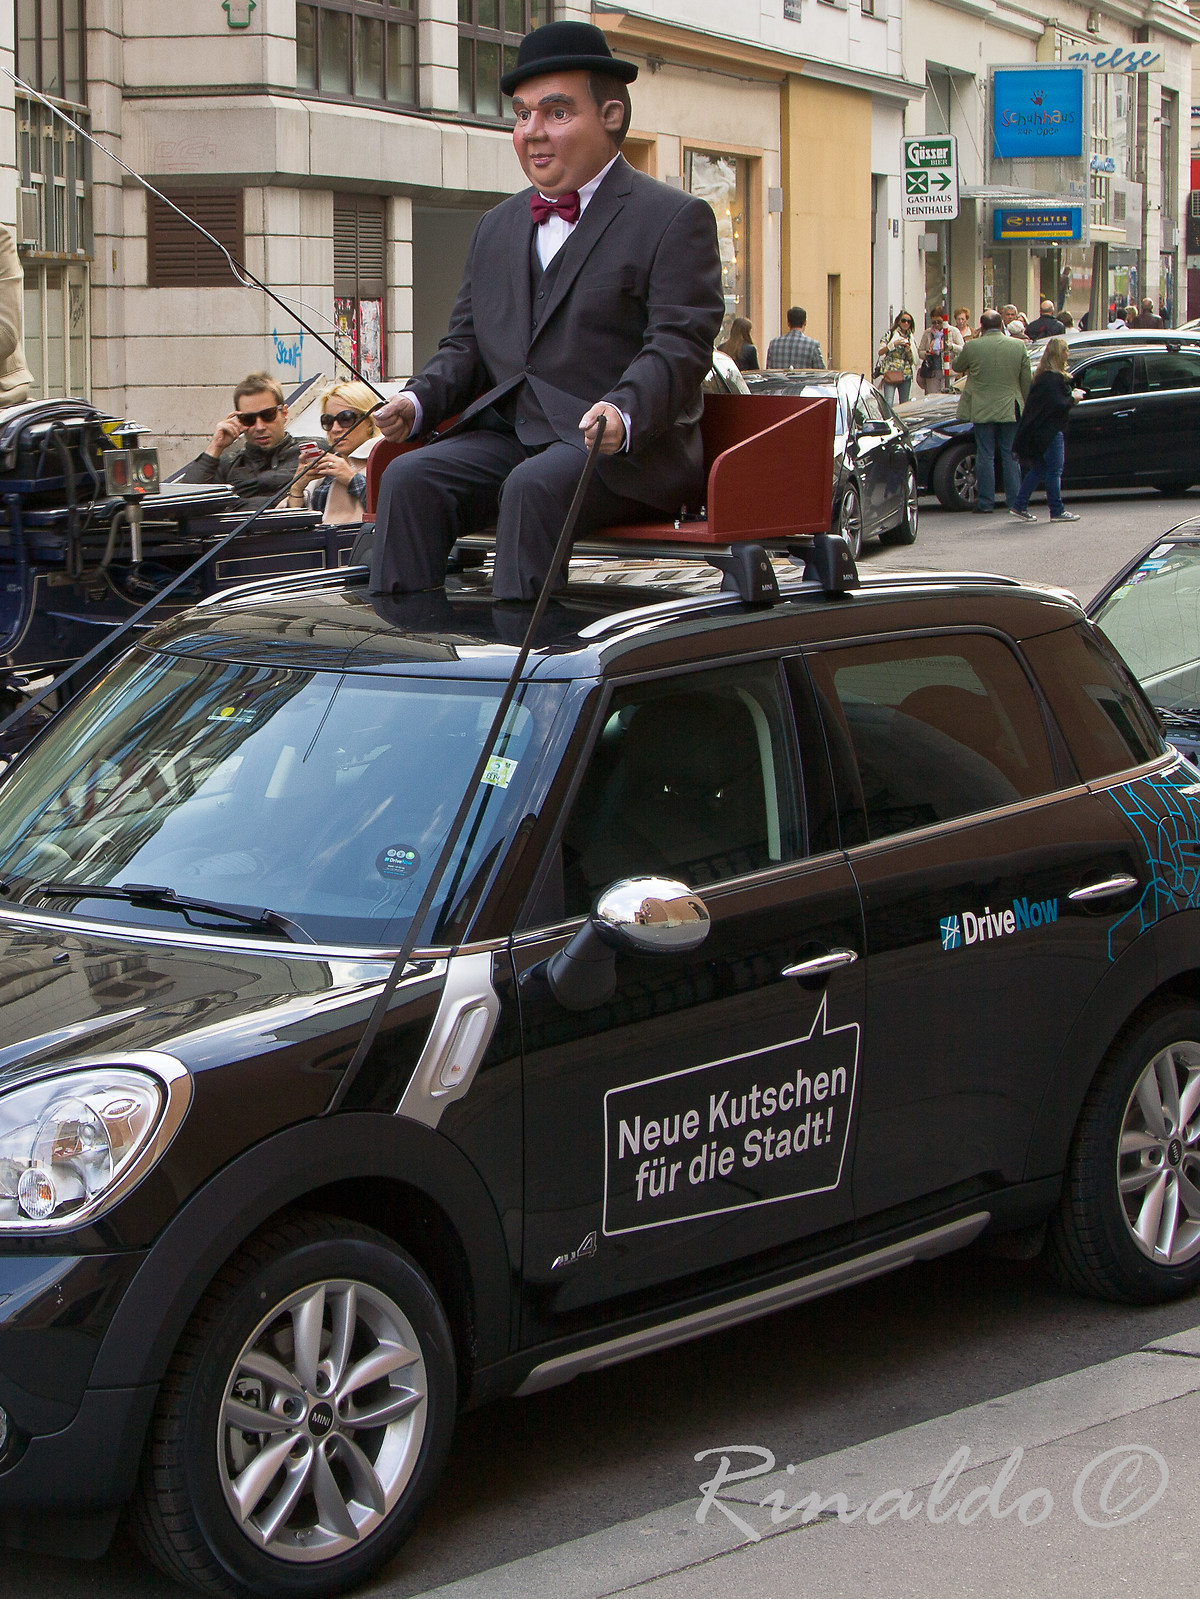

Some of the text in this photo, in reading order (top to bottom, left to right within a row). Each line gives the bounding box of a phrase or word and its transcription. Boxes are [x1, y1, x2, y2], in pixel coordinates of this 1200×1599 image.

[1001, 109, 1075, 127] Schuhhaus
[907, 142, 949, 167] Gösser
[907, 195, 952, 204] GASTHAUS
[906, 206, 953, 215] REINTHALER
[962, 897, 1058, 945] DriveNow
[618, 1066, 847, 1159] Neue Kutschen
[635, 1106, 834, 1201] für die Stadt!
[311, 1412, 331, 1427] MINI
